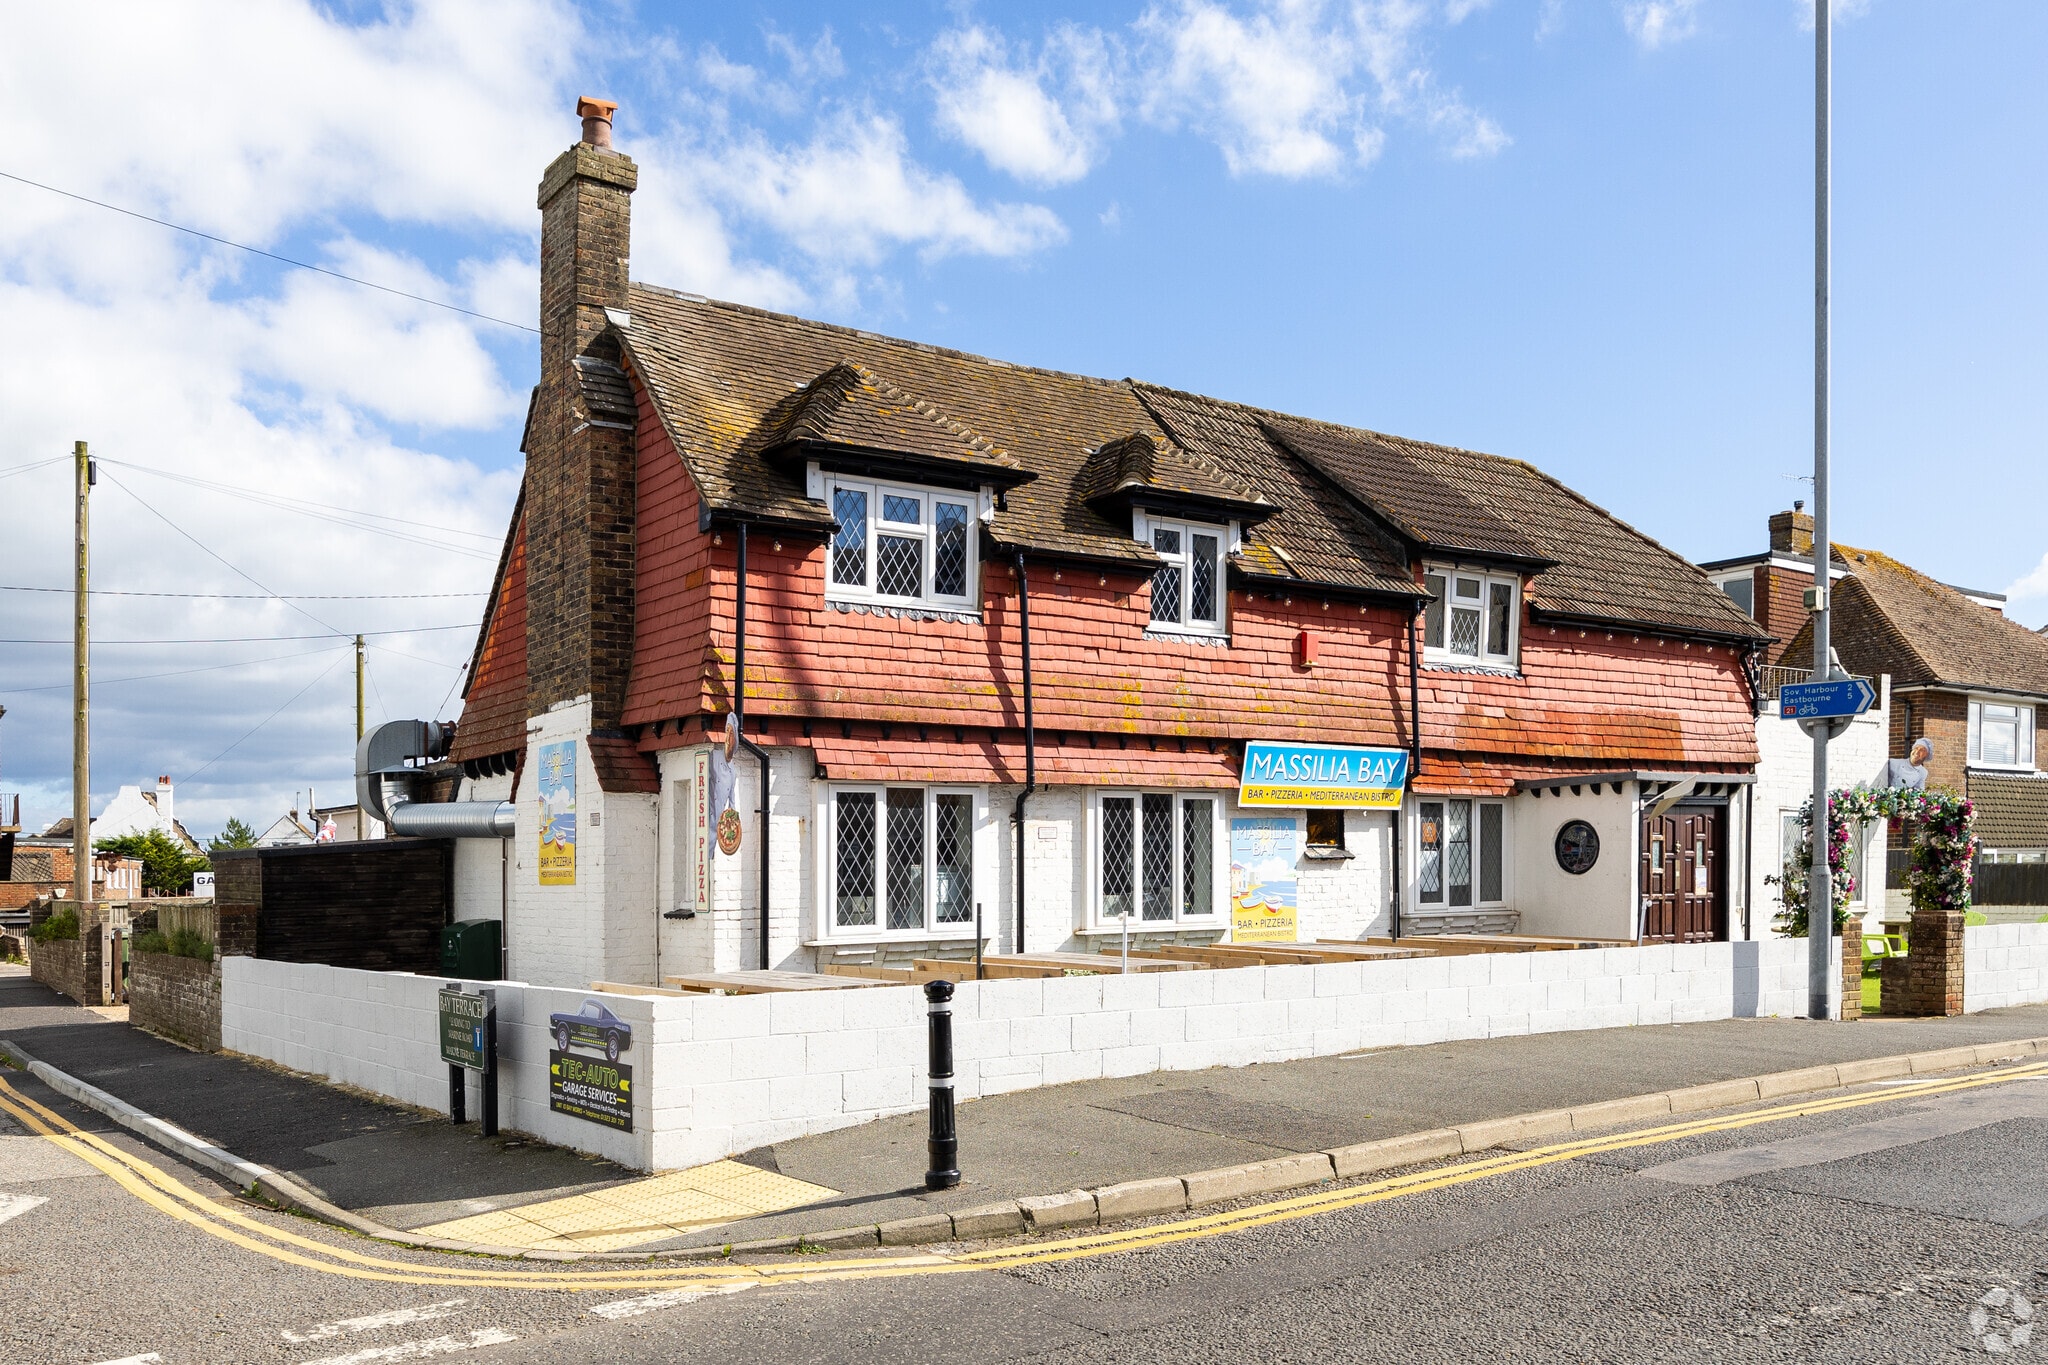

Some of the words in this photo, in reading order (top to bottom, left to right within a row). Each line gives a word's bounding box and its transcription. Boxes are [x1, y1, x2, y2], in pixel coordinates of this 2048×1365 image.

[1784, 695, 1831, 704] Eastbourne
[1250, 752, 1350, 782] MASSILIA
[1358, 757, 1400, 783] BAY
[1248, 789, 1263, 799] BAR
[1271, 790, 1303, 800] PIZZERIA
[1310, 791, 1369, 801] MEDITERRANEAN
[1371, 792, 1395, 802] BISTRO
[1236, 825, 1292, 840] MASSILIA
[1252, 841, 1277, 856] BAY
[541, 857, 549, 867] BAR
[553, 856, 572, 866] PIZZERIA
[1238, 920, 1253, 929] BAR
[1260, 918, 1293, 928] PIZZERIA
[440, 996, 451, 1012] BAY
[452, 998, 482, 1018] TERRACE
[562, 1058, 618, 1089] TEC-AUTO
[562, 1081, 587, 1097] GARAGE
[588, 1087, 617, 1105] SERVICES
